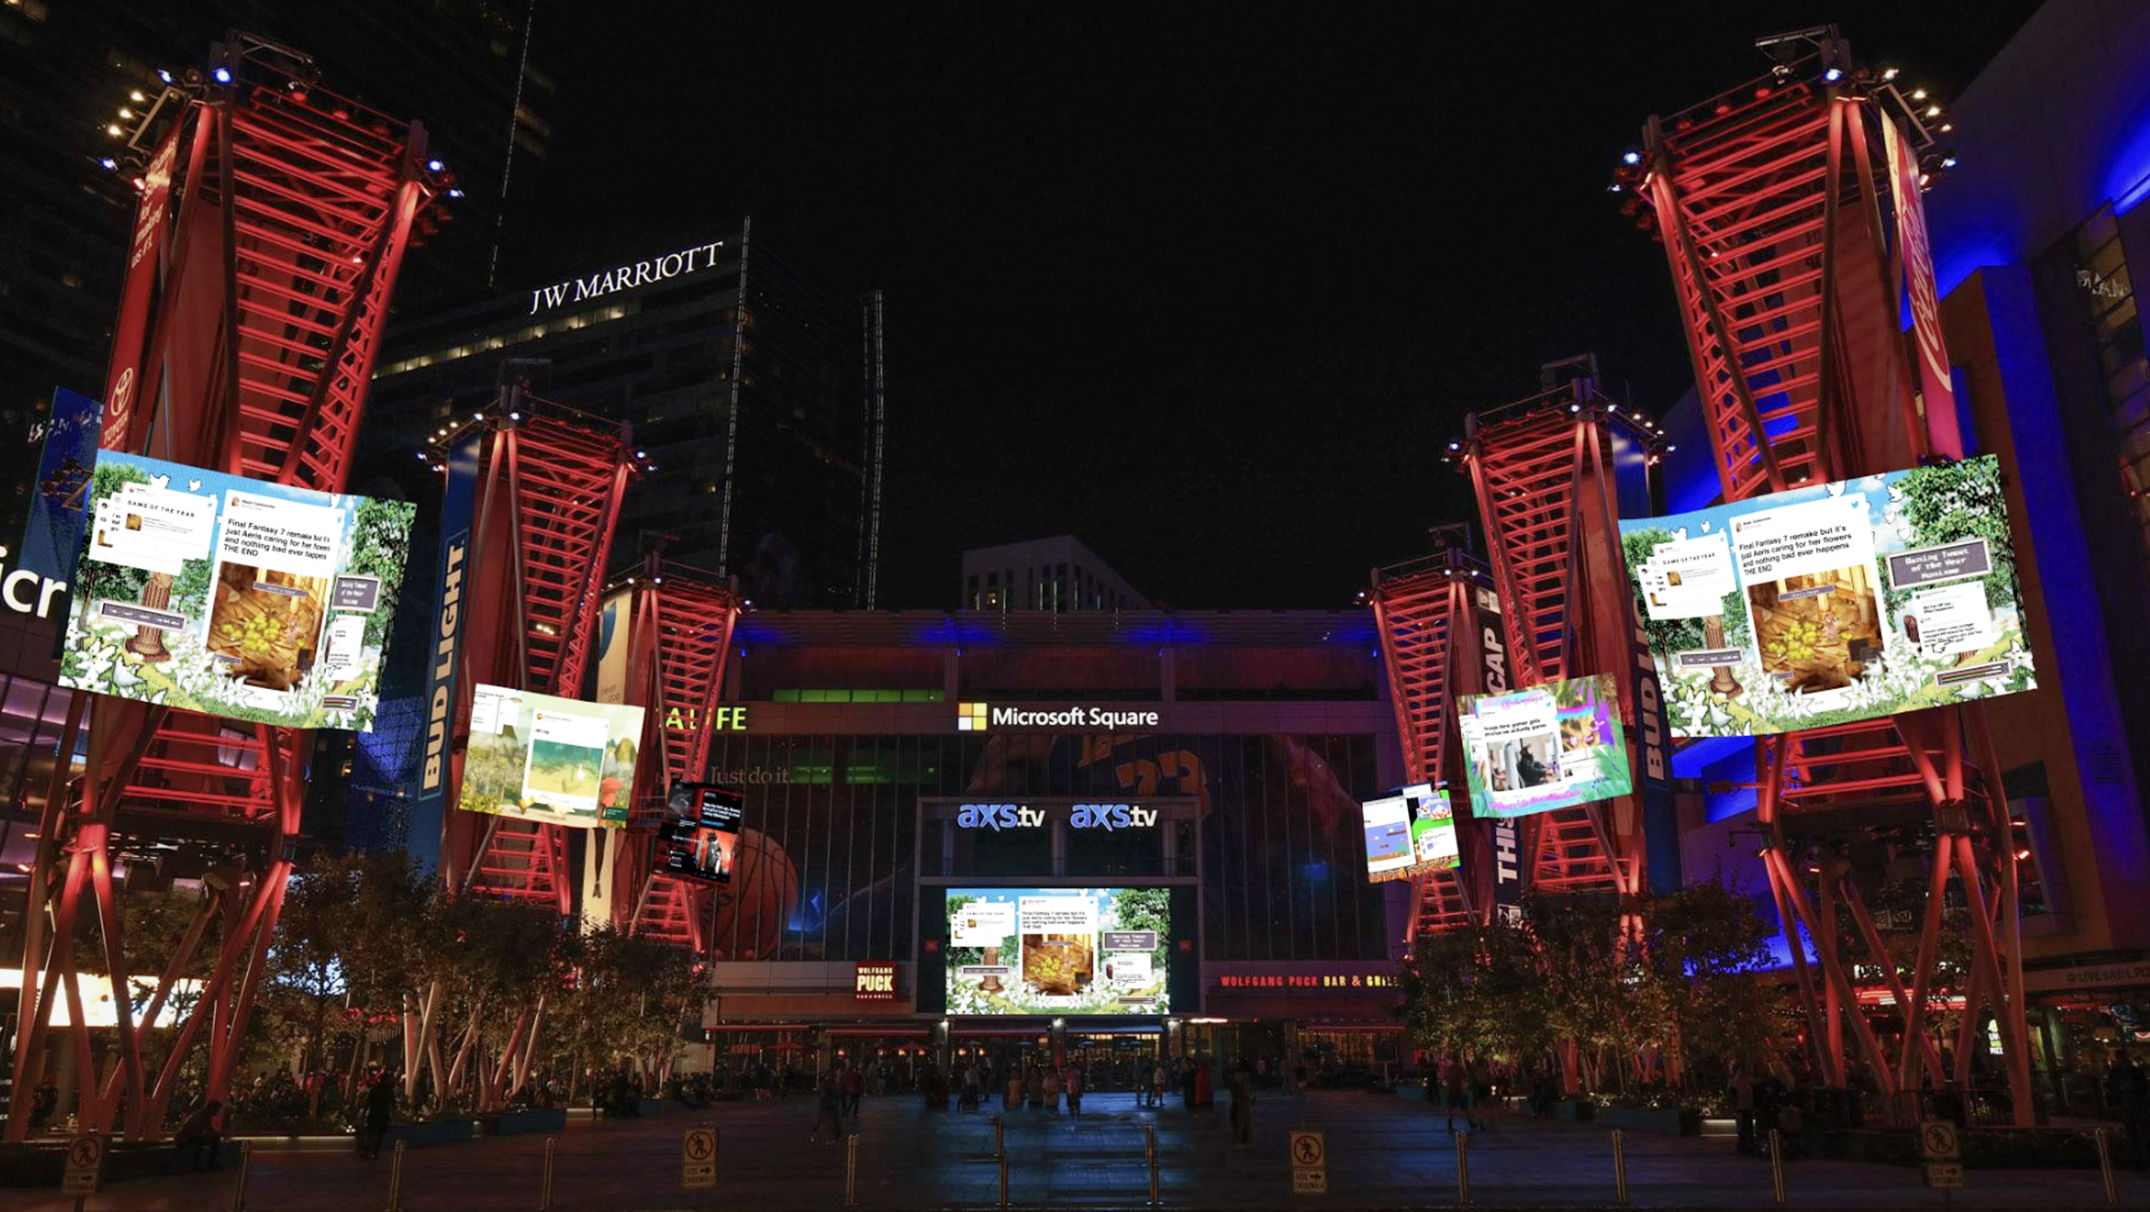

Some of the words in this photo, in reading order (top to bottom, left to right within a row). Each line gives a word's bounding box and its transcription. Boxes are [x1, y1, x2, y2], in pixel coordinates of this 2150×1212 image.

[530, 282, 569, 315] JW
[574, 241, 724, 301] MARRIOTT
[227, 518, 247, 528] Final
[248, 522, 278, 535] Fantasy
[1790, 530, 1818, 540] remake
[1820, 527, 1833, 536] but
[223, 544, 239, 553] THE
[241, 548, 259, 557] END
[1795, 540, 1806, 549] for
[1809, 538, 1821, 546] her
[1816, 543, 1849, 554] happens
[423, 684, 448, 789] BUD
[436, 545, 465, 681] LIGHT
[1484, 627, 1507, 696] CAP
[656, 707, 747, 731] ALIFE
[992, 706, 1085, 726] Microsoft
[1089, 708, 1159, 730] Square
[1641, 677, 1665, 781] BUD
[711, 767, 745, 784] Just
[749, 767, 772, 784] do
[776, 767, 794, 784] it.
[857, 975, 893, 992] PUCK
[1220, 975, 1284, 987] WOLFGANG
[1288, 975, 1319, 987] PUCK
[1323, 975, 1347, 987] BAR
[1351, 975, 1361, 987] &
